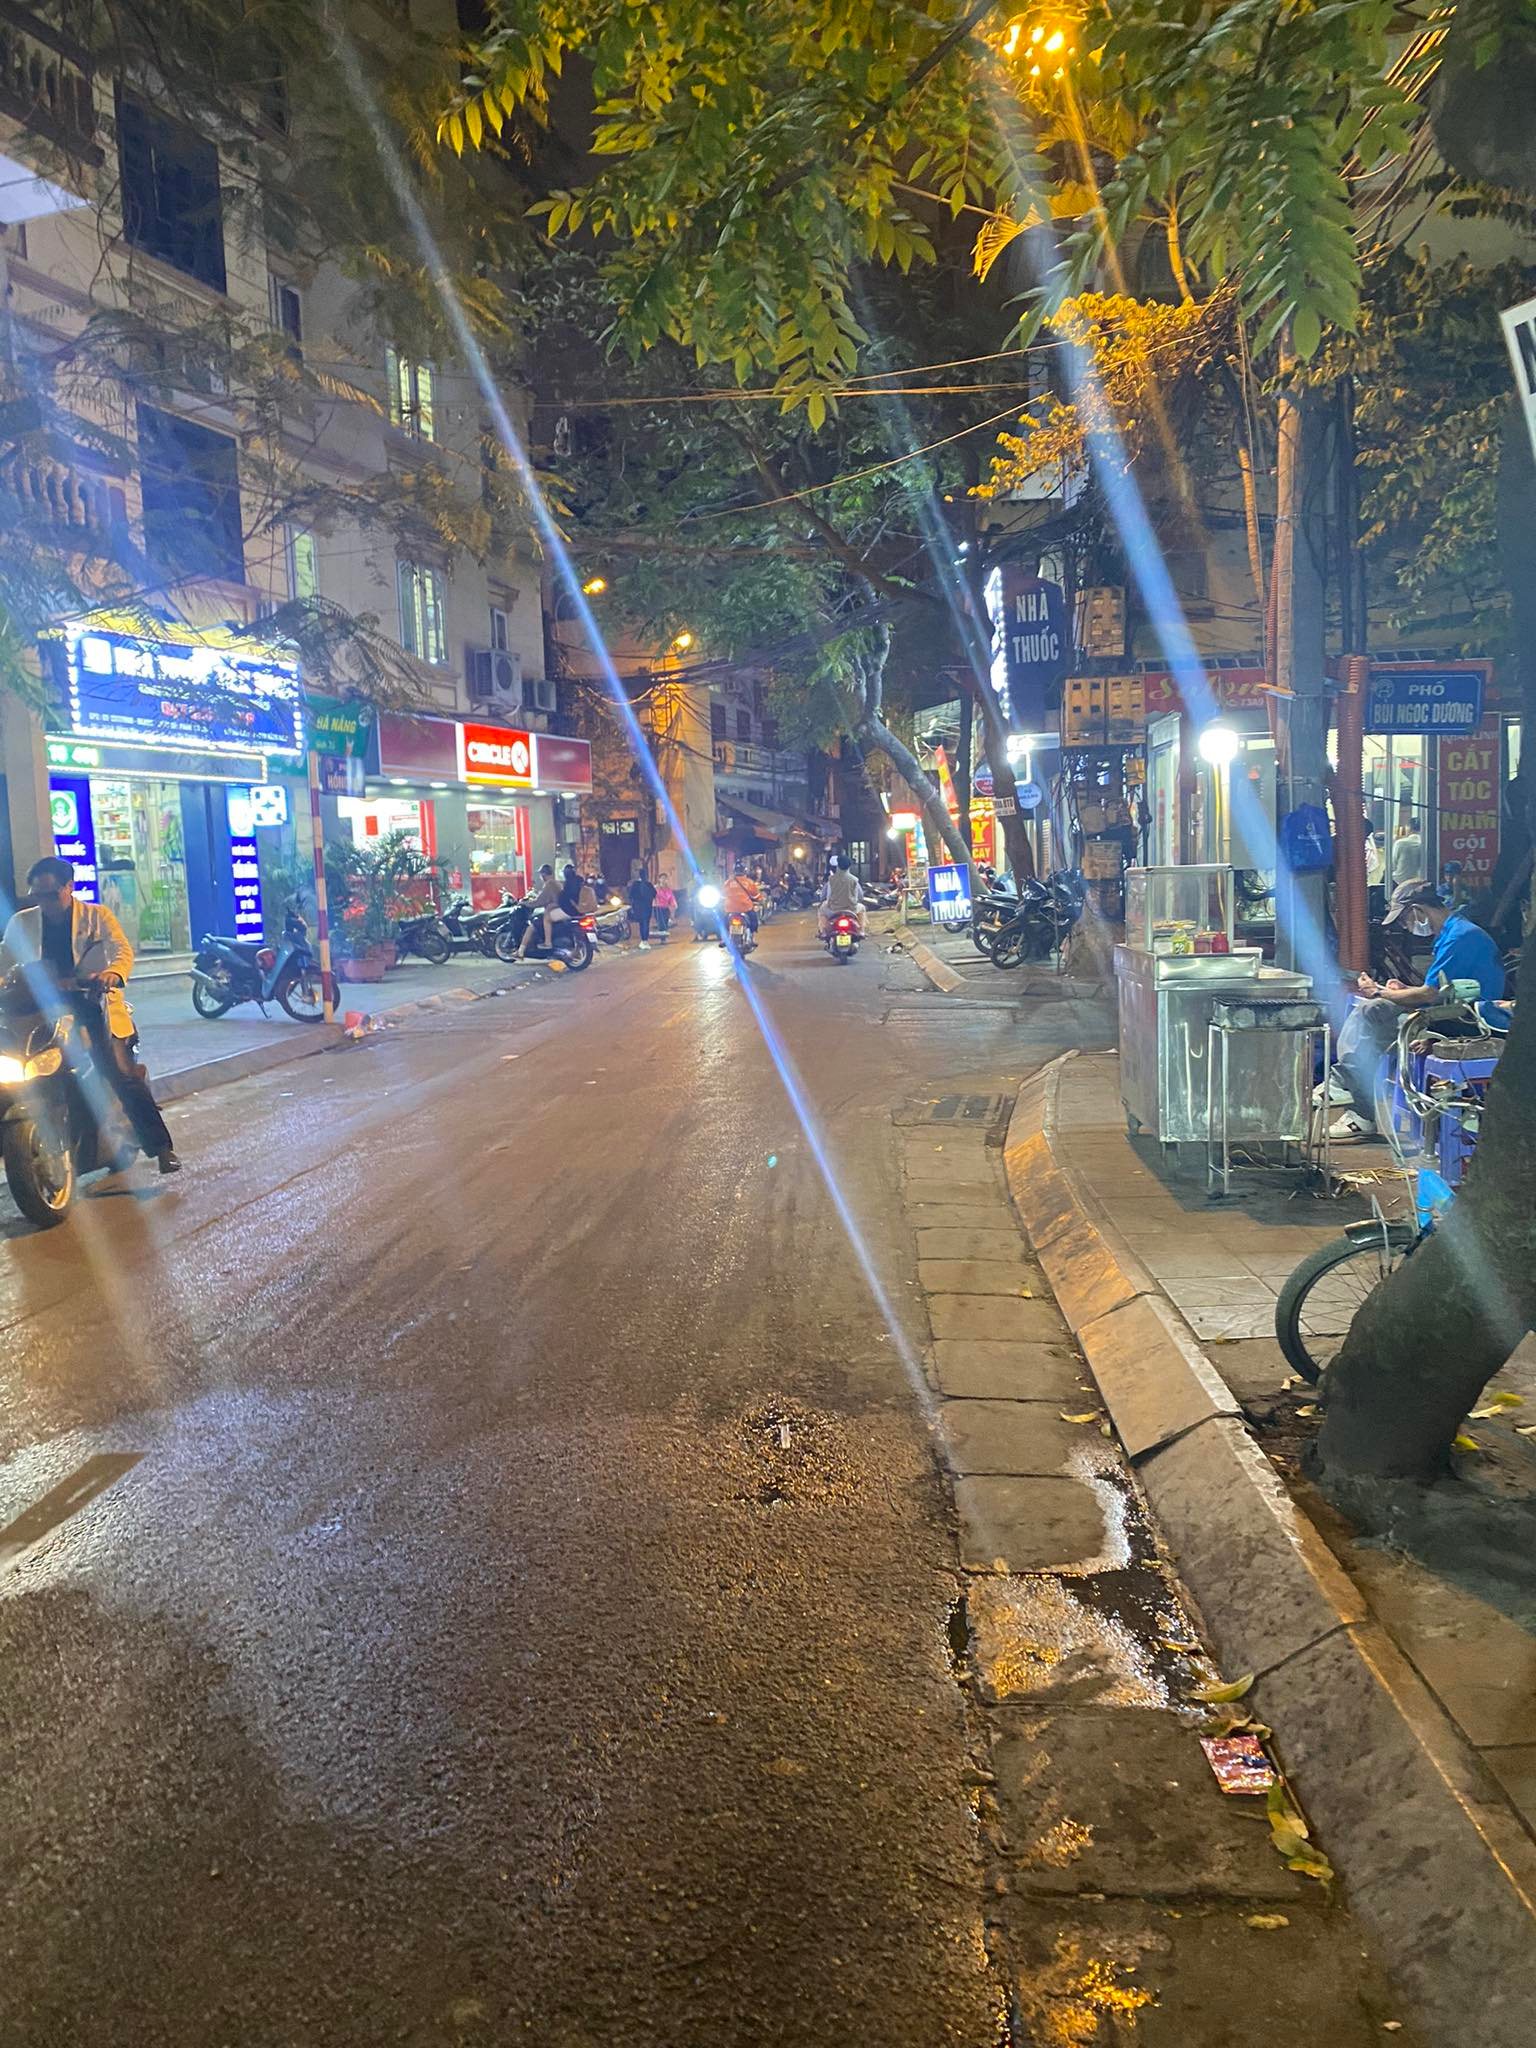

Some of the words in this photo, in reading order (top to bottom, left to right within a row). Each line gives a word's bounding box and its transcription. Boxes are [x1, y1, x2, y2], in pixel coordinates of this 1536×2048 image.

[1016, 588, 1049, 622] NHÀ
[1012, 626, 1059, 663] THUỐC
[1408, 680, 1446, 696] PHỐ
[1374, 699, 1394, 723] BÙI
[1396, 703, 1429, 727] NGỌC
[468, 742, 511, 766] CIRCLE
[1447, 743, 1492, 772] CẮT
[1447, 778, 1491, 801] TÓC
[1441, 810, 1498, 831] NAM
[935, 867, 962, 893] NHÀ
[932, 892, 972, 921] THUỐC
